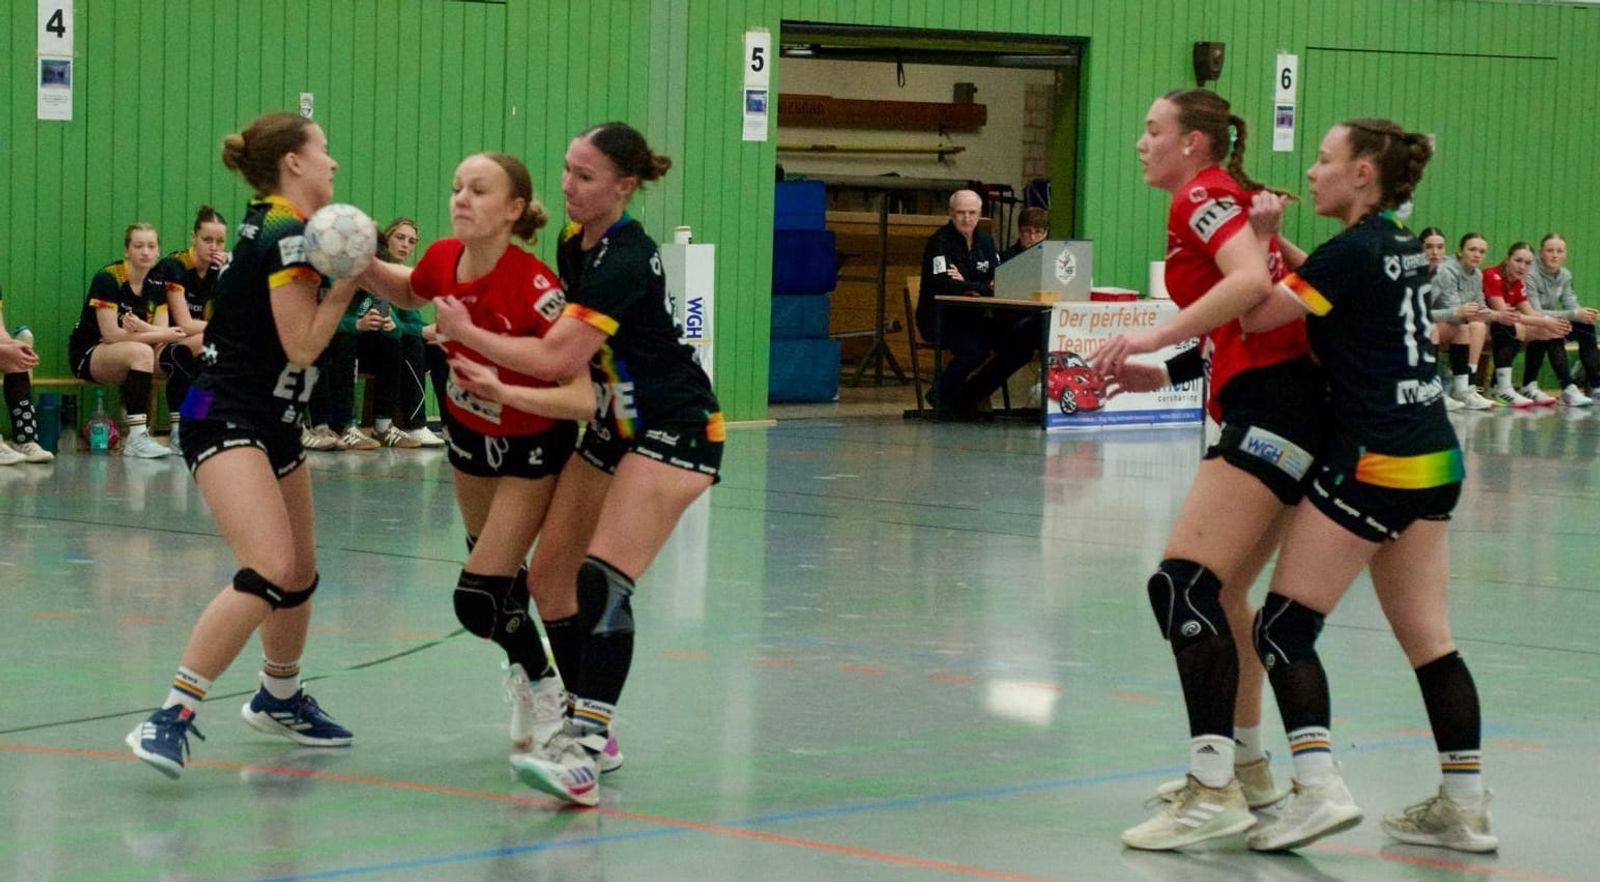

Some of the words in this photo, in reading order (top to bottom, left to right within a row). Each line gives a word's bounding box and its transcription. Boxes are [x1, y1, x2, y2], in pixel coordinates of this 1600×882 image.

[46, 9, 65, 38] 4
[751, 47, 764, 72] 5
[1281, 68, 1292, 89] 6
[686, 297, 702, 339] WGH
[1059, 308, 1086, 328] Der
[1089, 309, 1156, 333] perfekte
[1248, 436, 1284, 463] WGH
